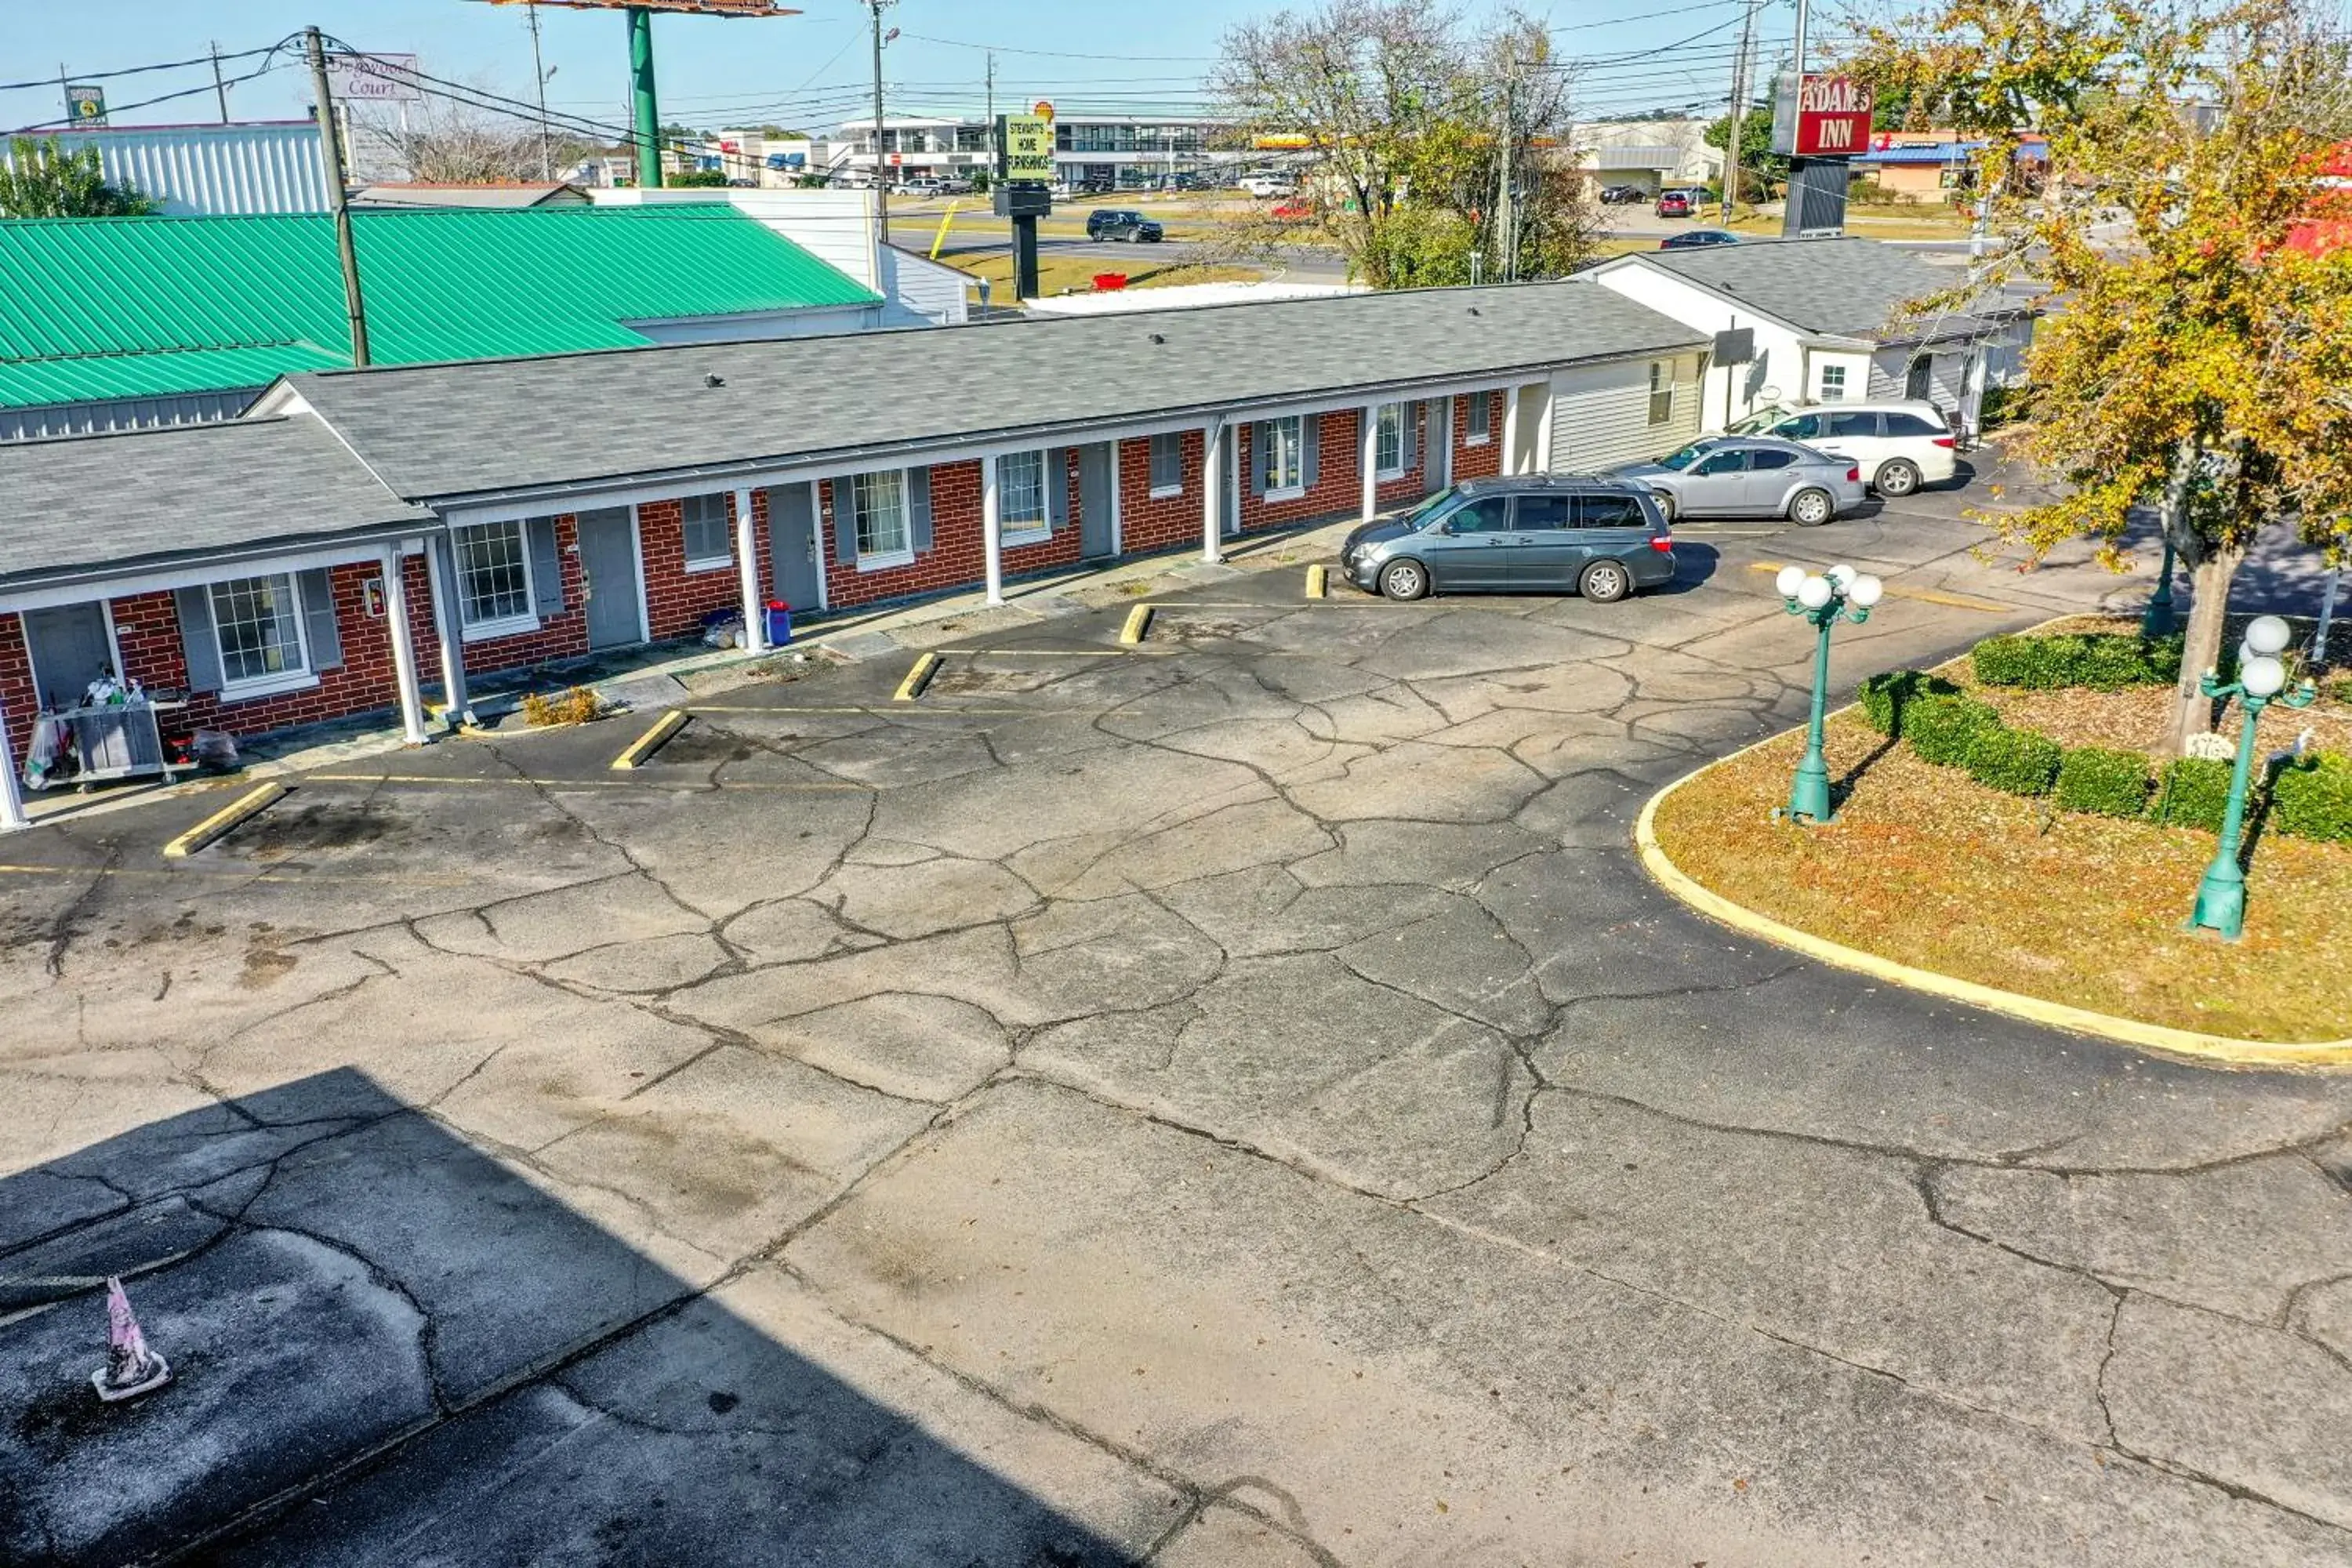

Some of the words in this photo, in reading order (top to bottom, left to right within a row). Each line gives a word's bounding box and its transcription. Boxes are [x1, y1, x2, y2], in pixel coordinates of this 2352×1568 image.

[349, 79, 395, 95] Court
[1818, 118, 1853, 148] INN
[1018, 137, 1037, 151] HOME
